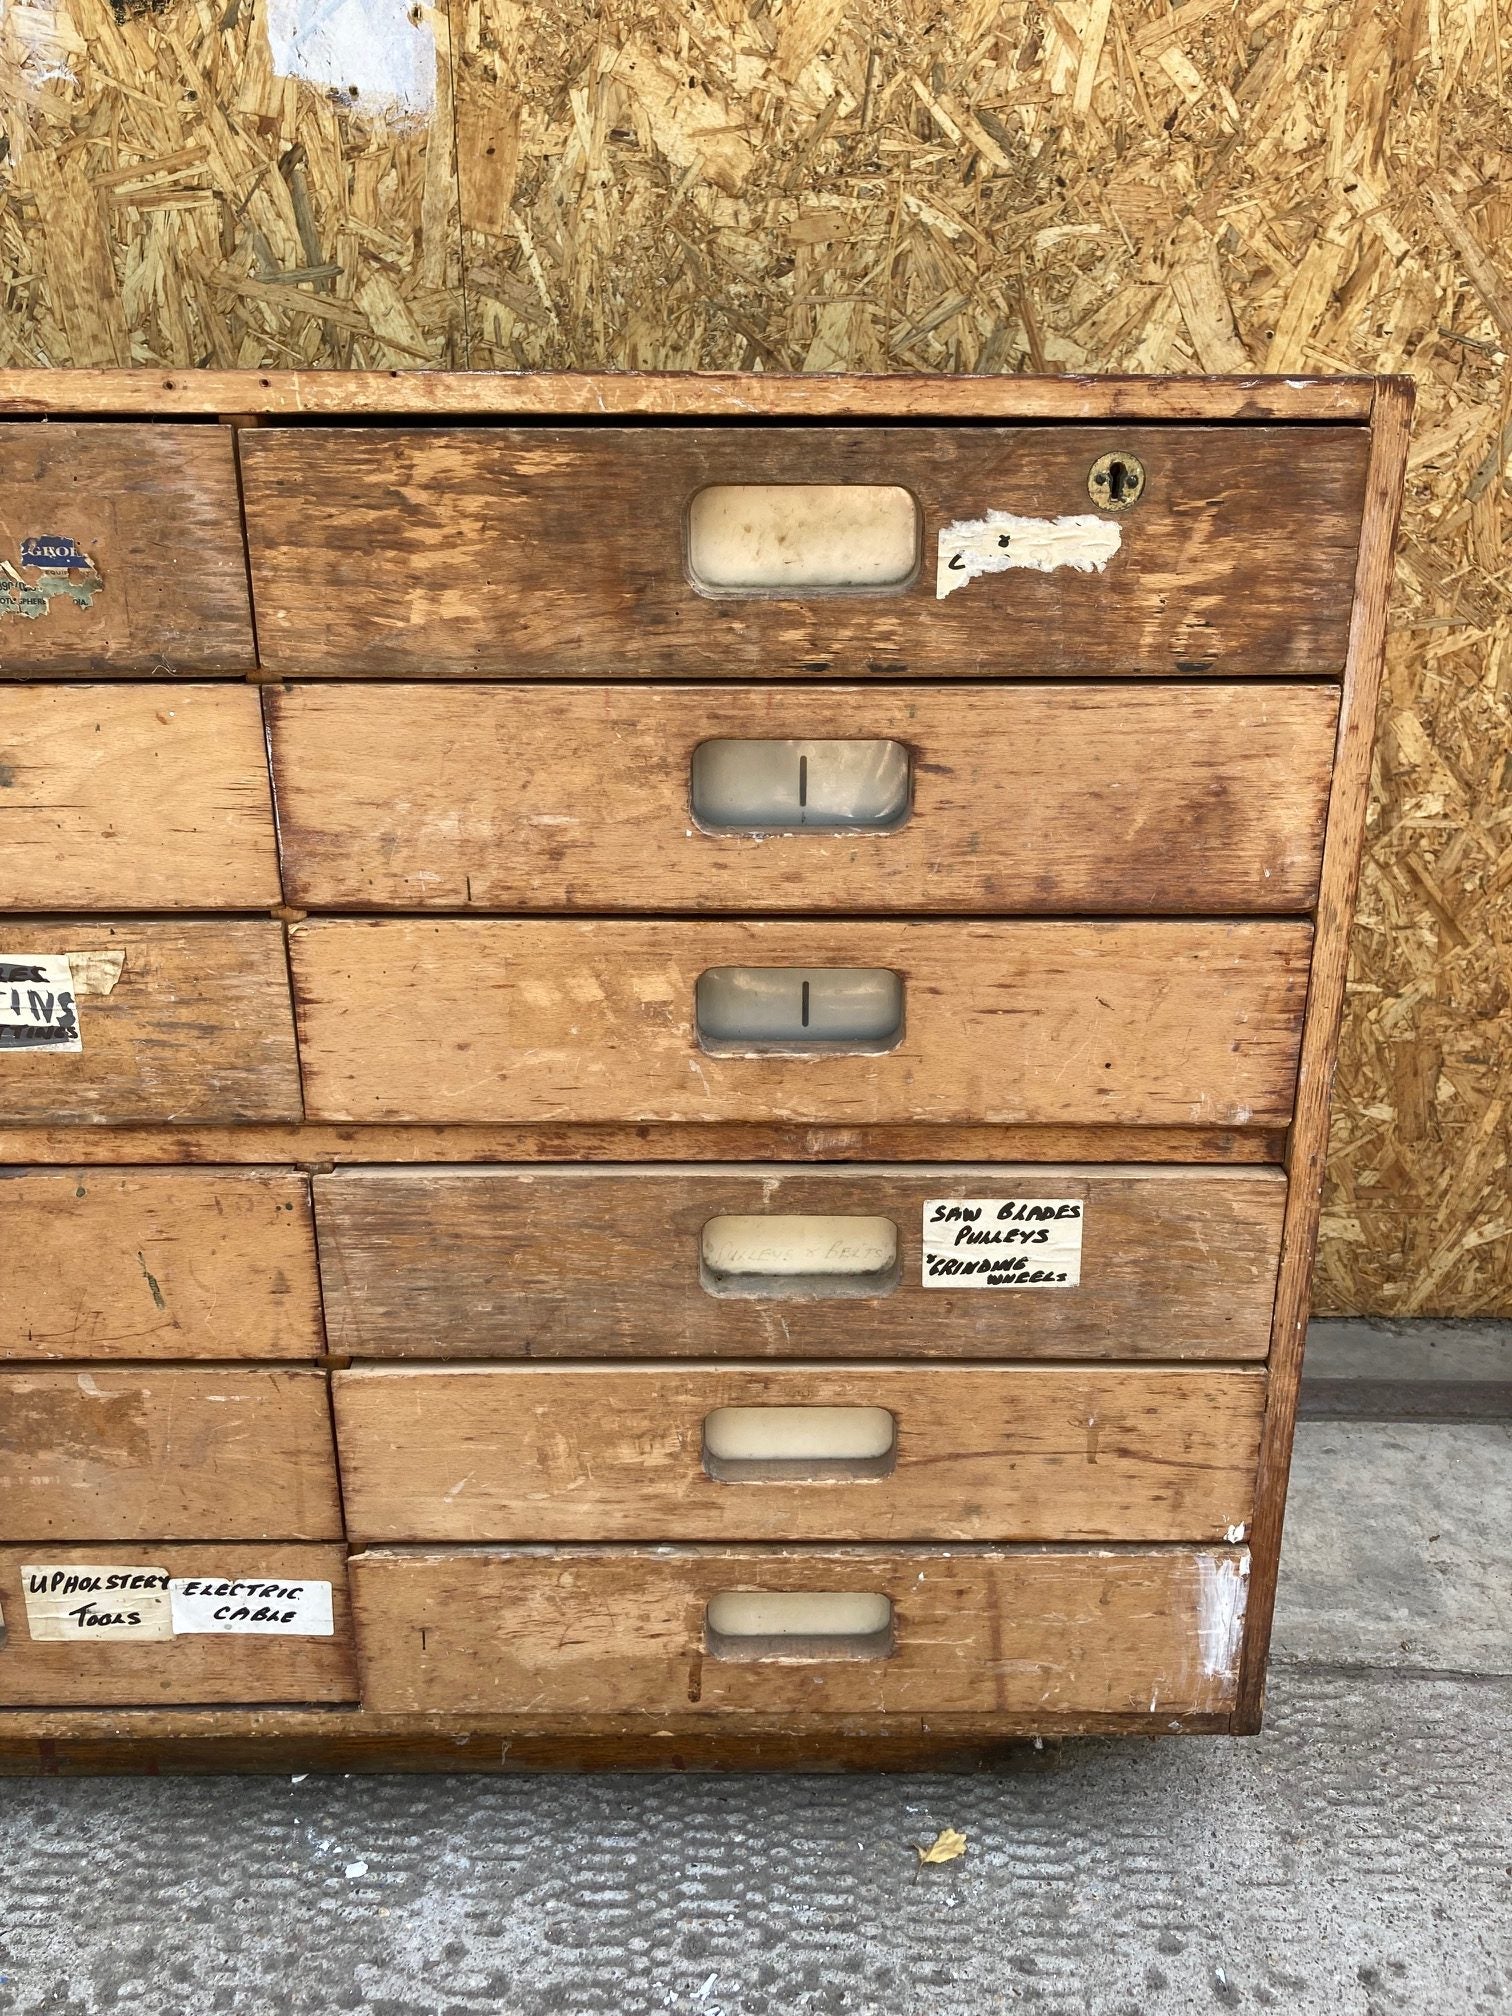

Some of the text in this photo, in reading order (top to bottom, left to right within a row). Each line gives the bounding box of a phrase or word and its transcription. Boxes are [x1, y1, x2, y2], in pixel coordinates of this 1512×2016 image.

[0, 988, 76, 1027] INS
[930, 1201, 1081, 1223] SAW BLADES
[953, 1225, 1050, 1247] PULLEYS
[929, 1256, 1030, 1276] GRINDING
[986, 1270, 1068, 1286] WHEELS
[29, 1570, 171, 1594] UPHOLSTERY
[182, 1580, 304, 1600] ELECTRIC
[69, 1602, 142, 1628] TOOLS
[213, 1606, 297, 1624] CABLE
